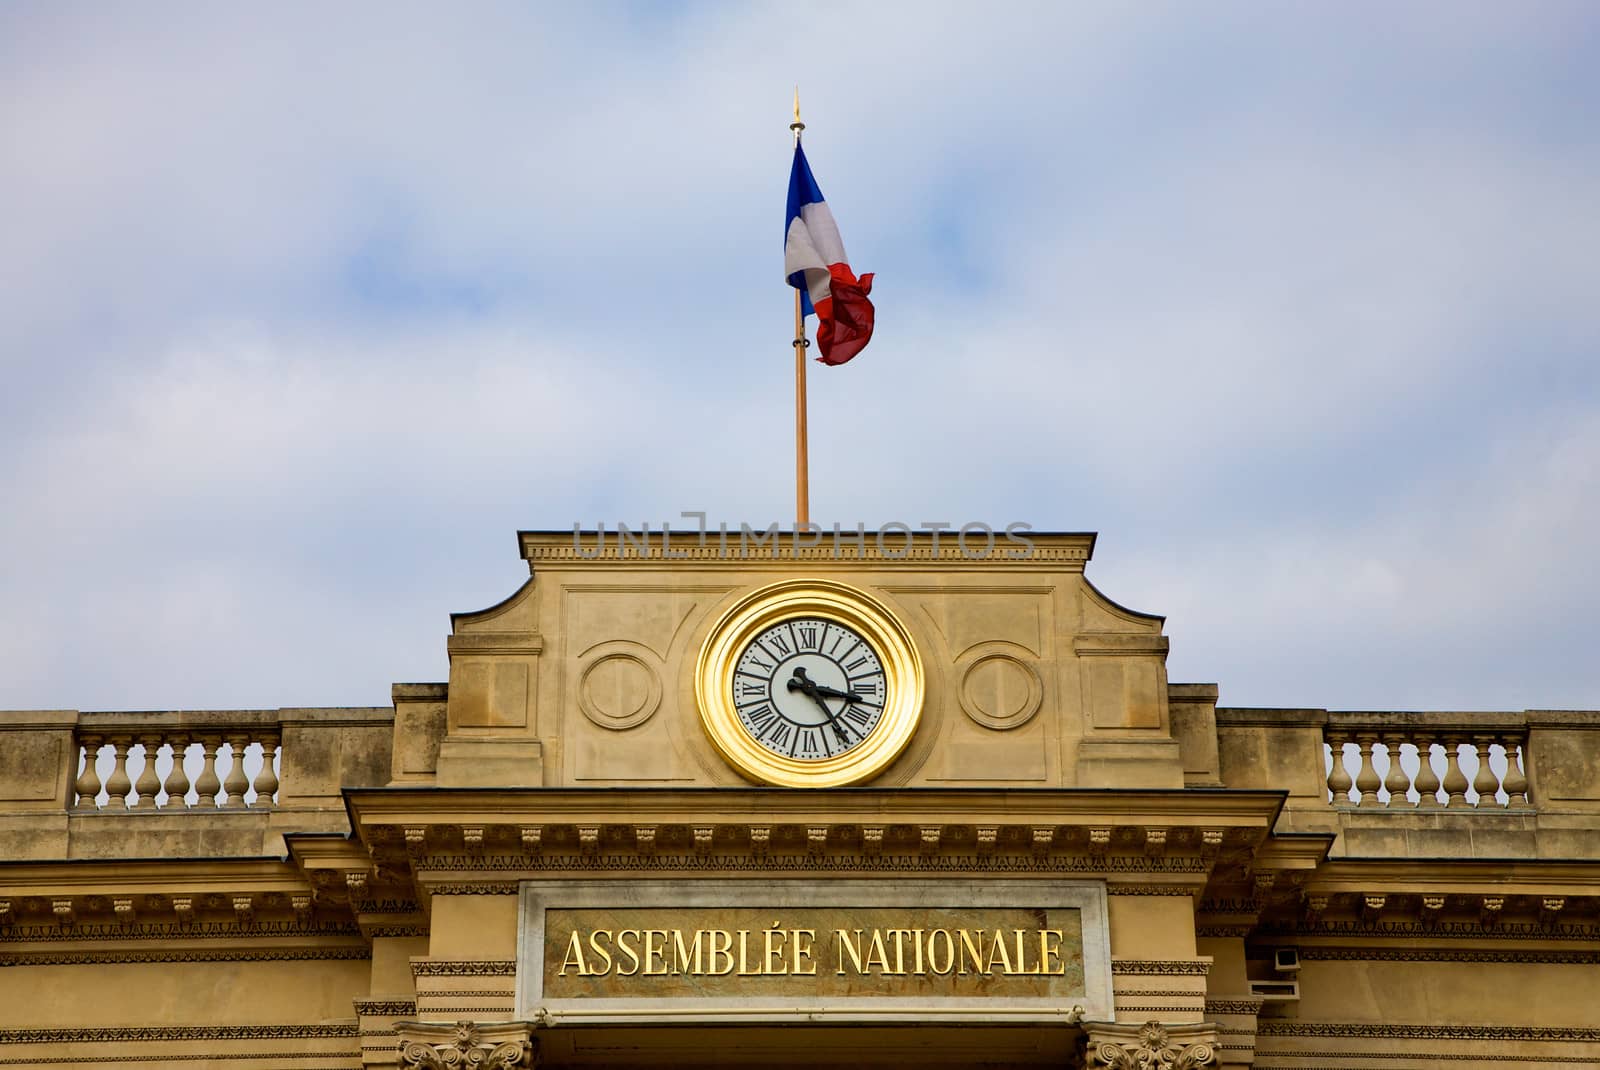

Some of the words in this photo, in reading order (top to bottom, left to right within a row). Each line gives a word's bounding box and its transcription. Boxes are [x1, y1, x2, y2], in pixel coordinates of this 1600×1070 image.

[769, 634, 791, 657] XI
[798, 628, 817, 649] XII
[750, 656, 773, 672] X
[845, 655, 868, 672] II
[742, 682, 766, 696] IX
[853, 683, 877, 696] III
[748, 704, 775, 731] VIII
[769, 722, 791, 748] VII
[803, 731, 818, 752] VI
[558, 921, 817, 976] ASSEMBLÉE
[835, 928, 1065, 976] NATIONALE
